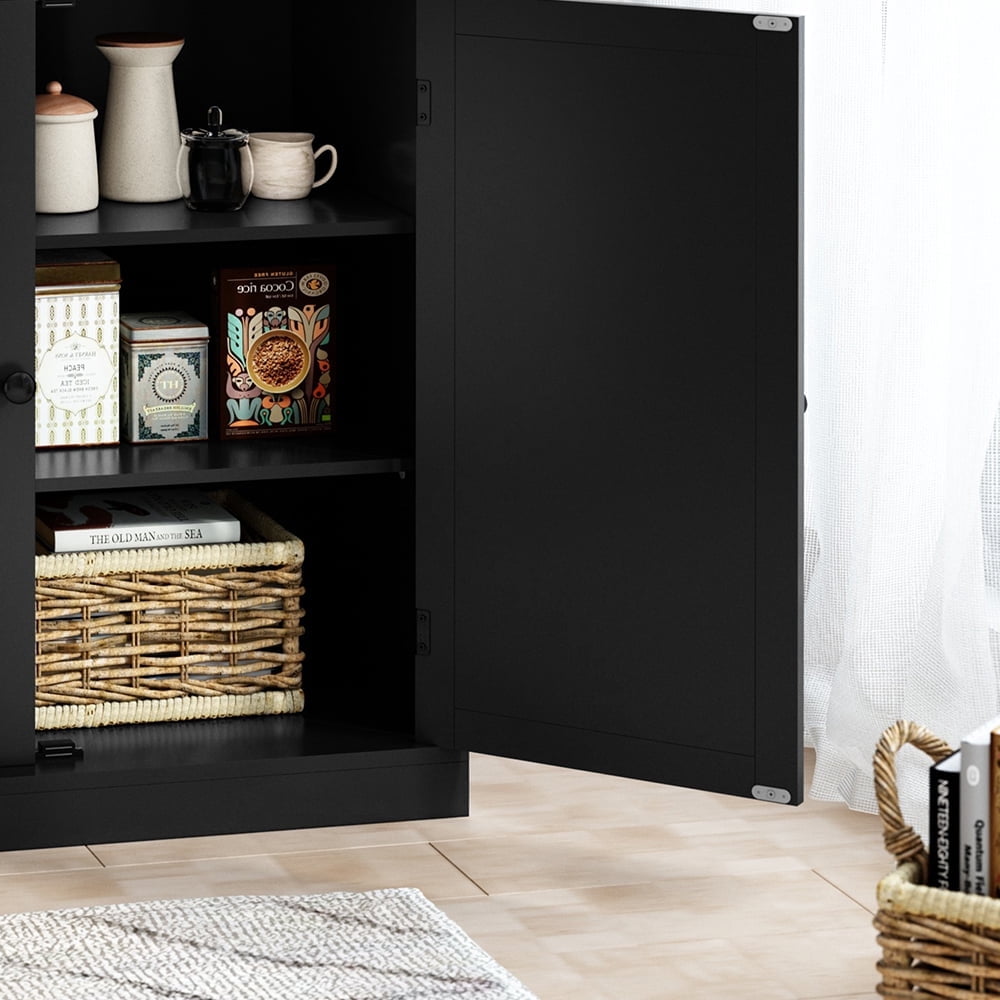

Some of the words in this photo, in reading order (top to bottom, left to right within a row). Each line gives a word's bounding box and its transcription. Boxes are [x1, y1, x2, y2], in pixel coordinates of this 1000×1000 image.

[89, 534, 110, 544] THE
[111, 533, 133, 543] OLD
[134, 531, 156, 542] MAN
[156, 533, 169, 541] AND
[184, 529, 203, 539] SEA
[974, 819, 985, 872] Quantum
